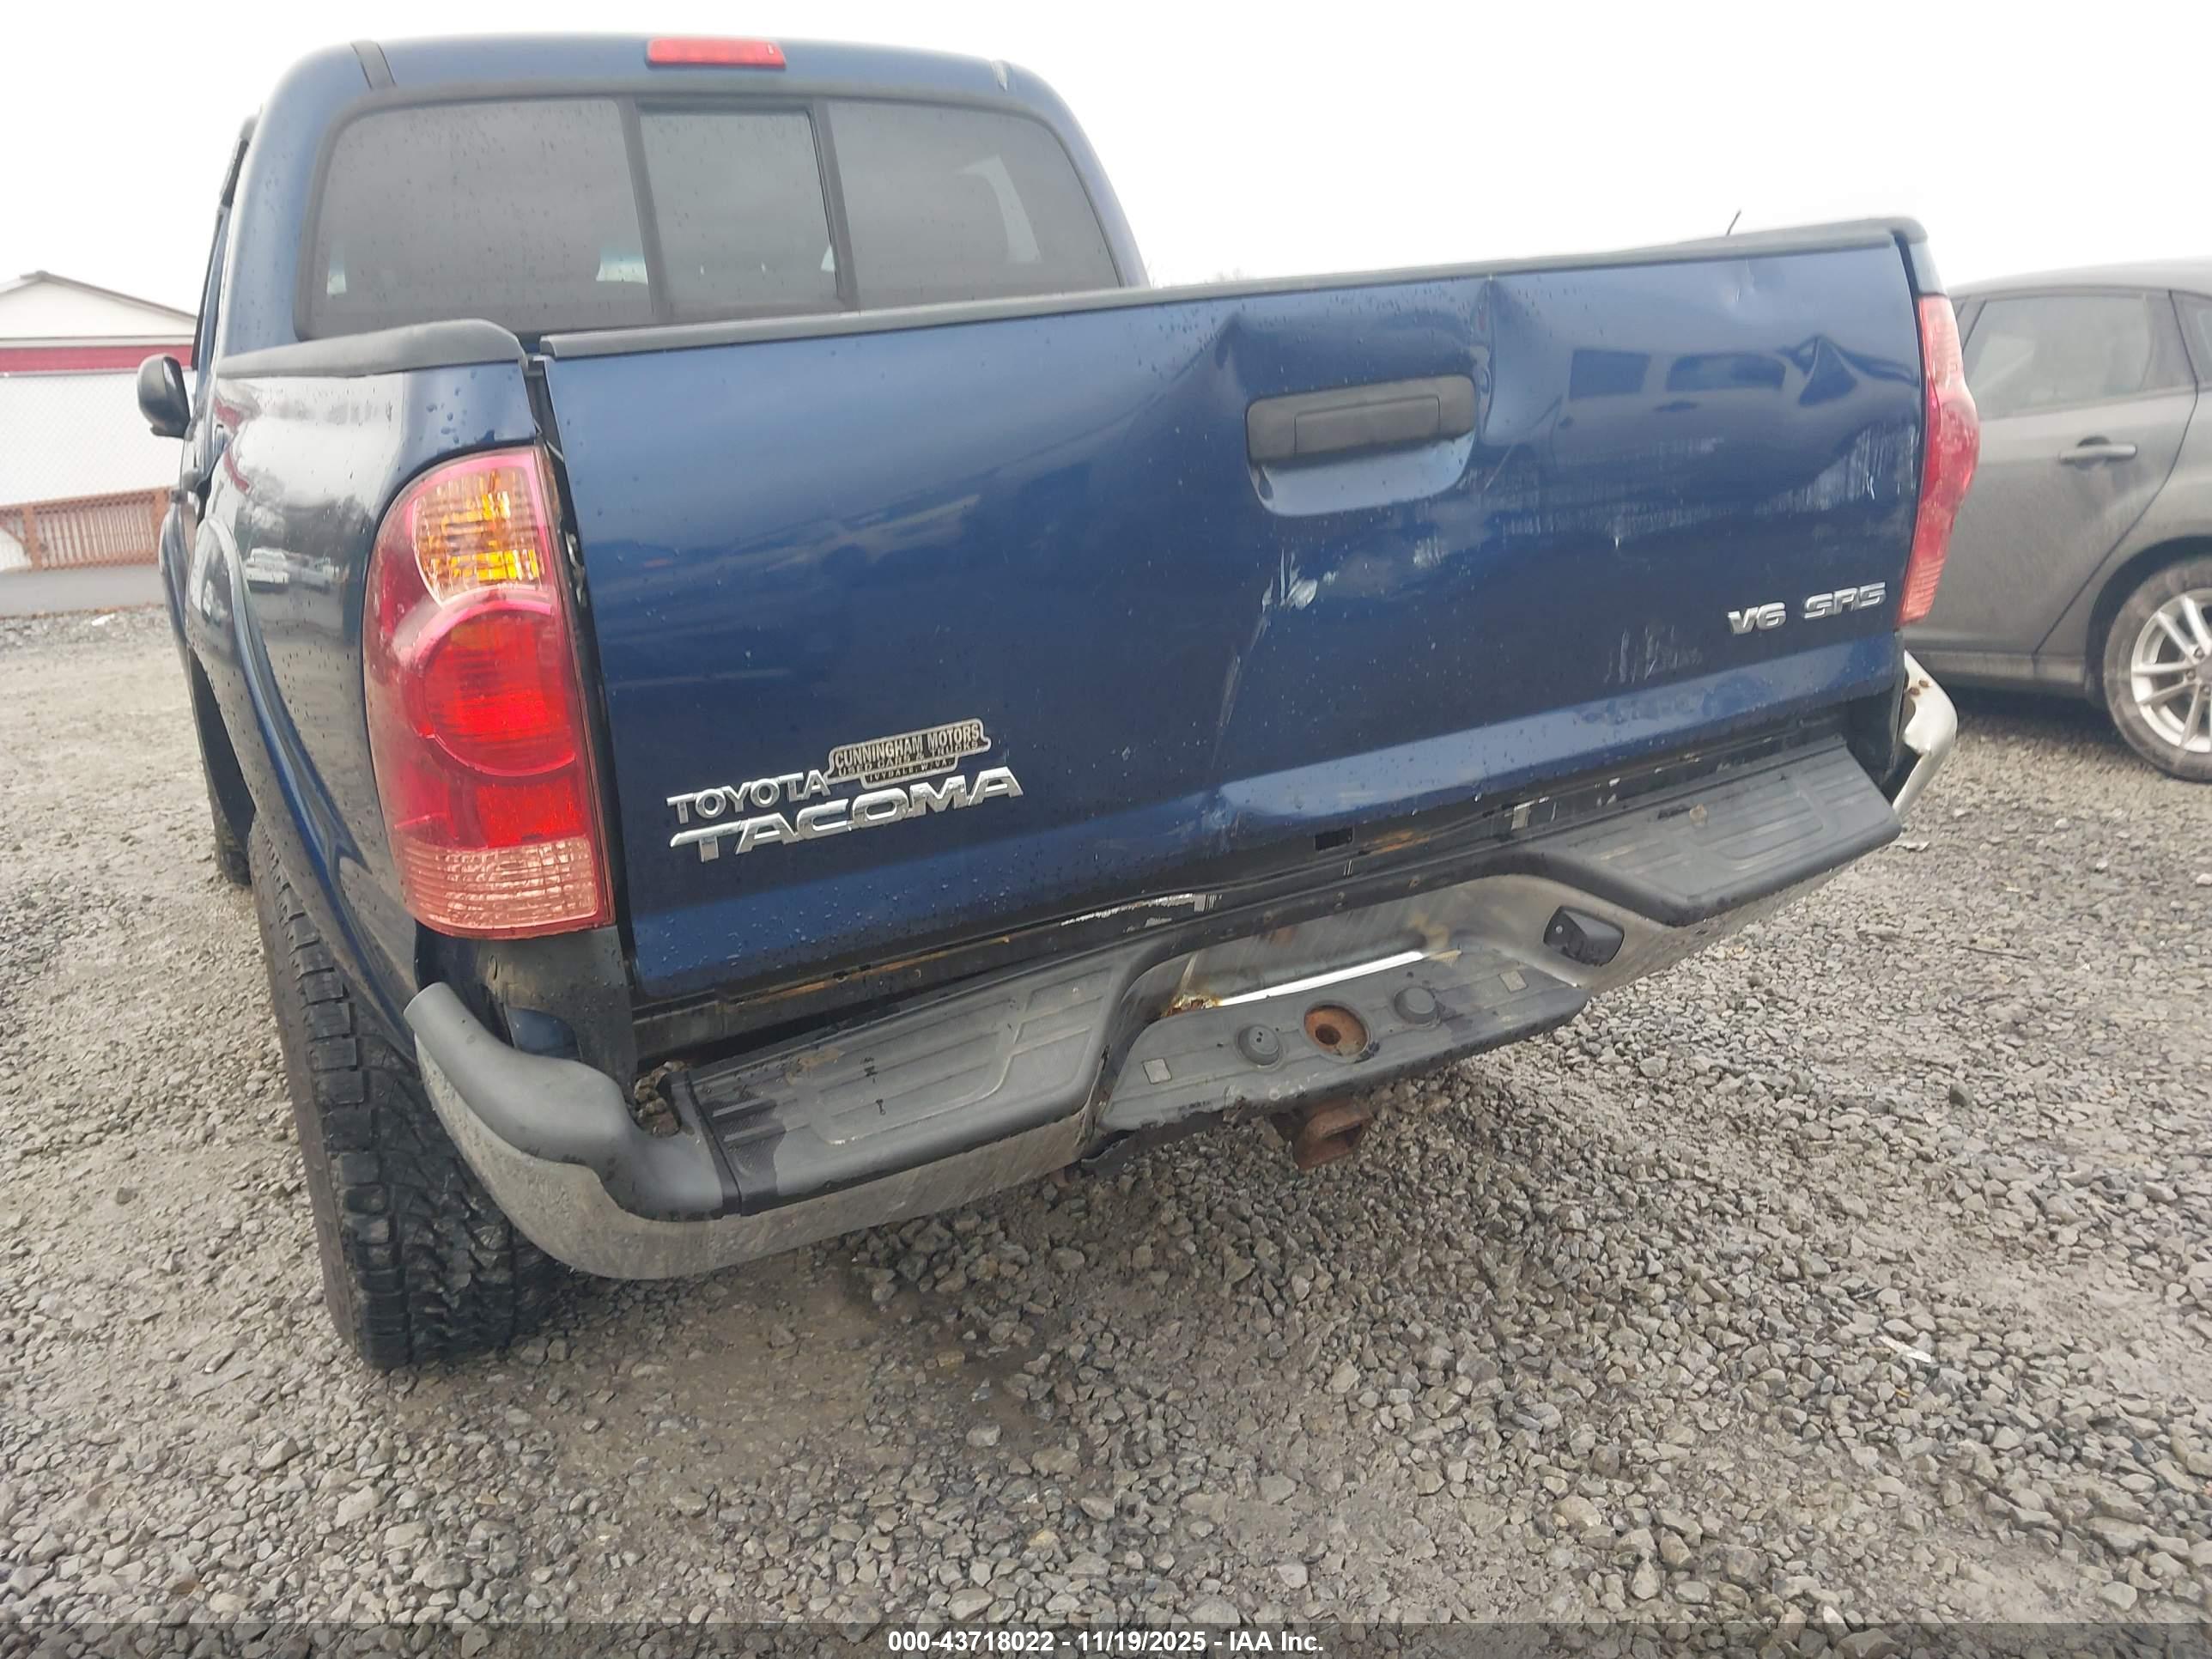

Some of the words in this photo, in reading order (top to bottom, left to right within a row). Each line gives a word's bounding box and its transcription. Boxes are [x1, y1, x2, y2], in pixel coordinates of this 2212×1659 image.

[1728, 602, 1786, 635] V6
[1805, 581, 1887, 619] SR5
[835, 736, 924, 769] CUNNINGHAM
[927, 724, 979, 750] MOTORS
[837, 762, 873, 777] USED
[878, 753, 911, 769] CARS
[929, 741, 979, 758] TRUCKS
[666, 769, 831, 824] TOYOTA
[670, 766, 1024, 863] TACOMA
